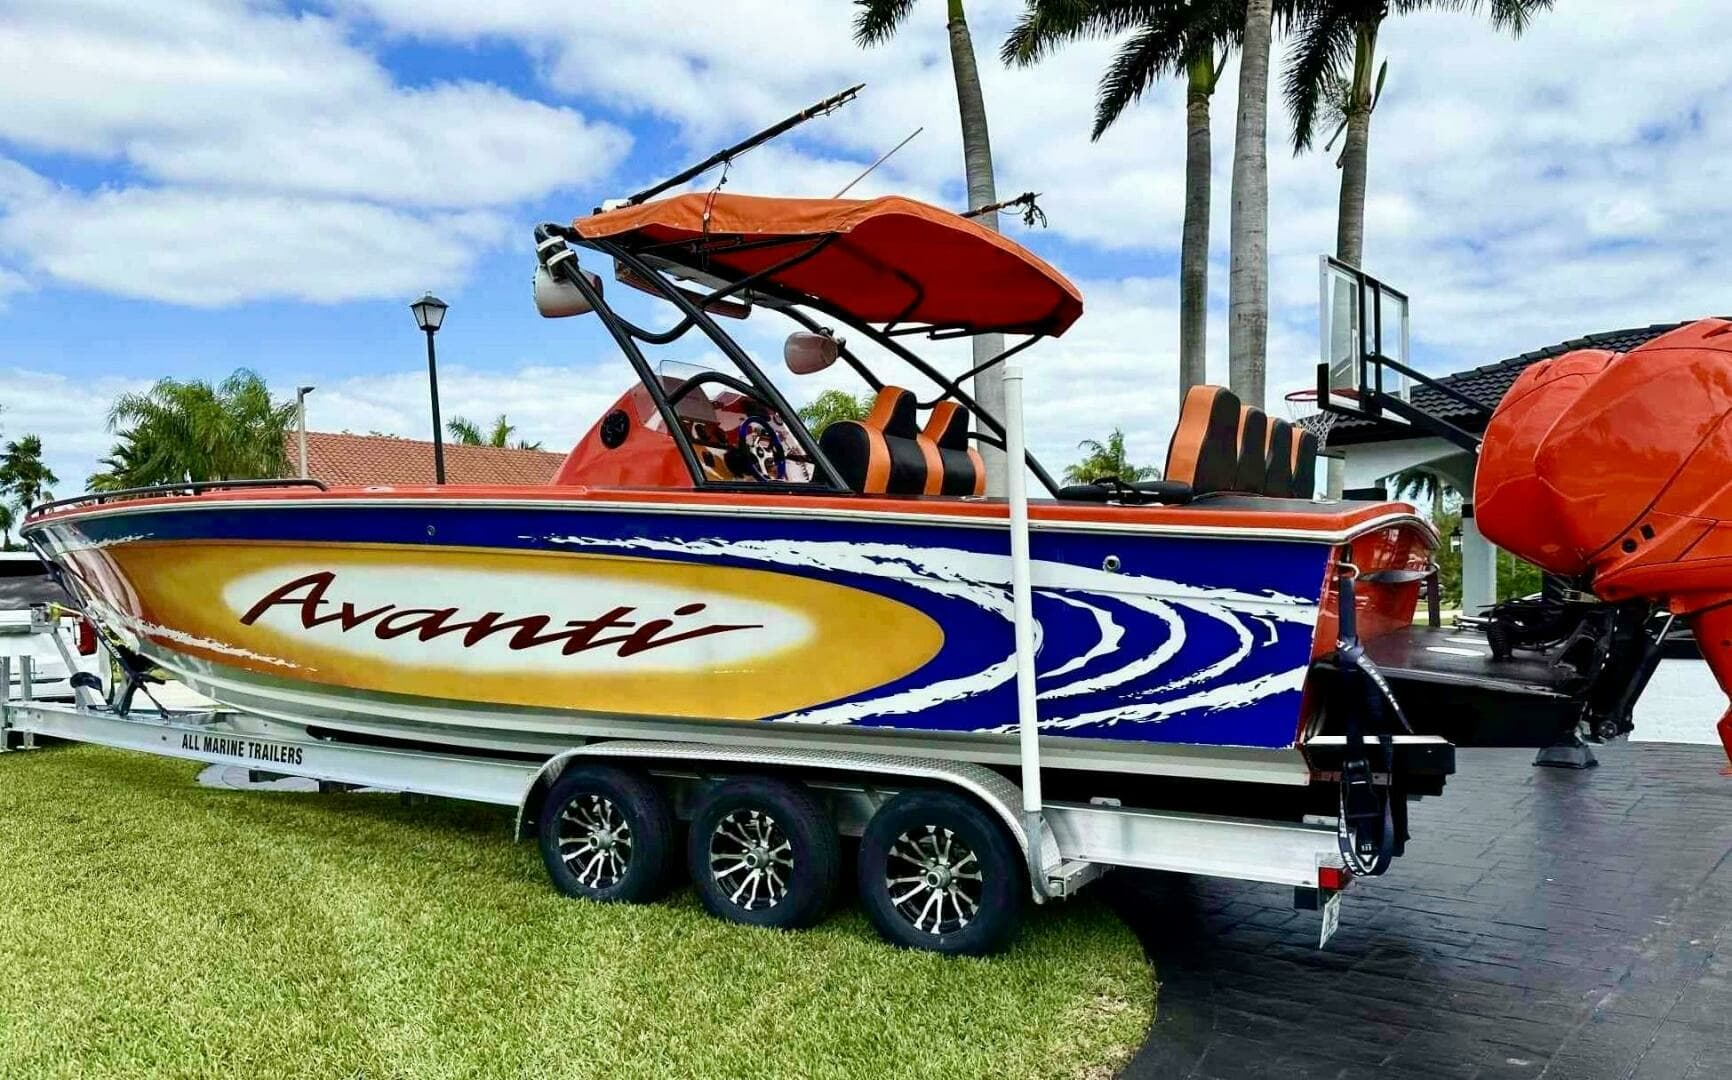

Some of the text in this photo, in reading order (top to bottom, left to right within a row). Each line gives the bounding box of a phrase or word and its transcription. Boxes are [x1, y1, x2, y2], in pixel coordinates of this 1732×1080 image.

[240, 571, 763, 657] Avanti
[182, 734, 303, 765] ALL MARINE TRAILERS
